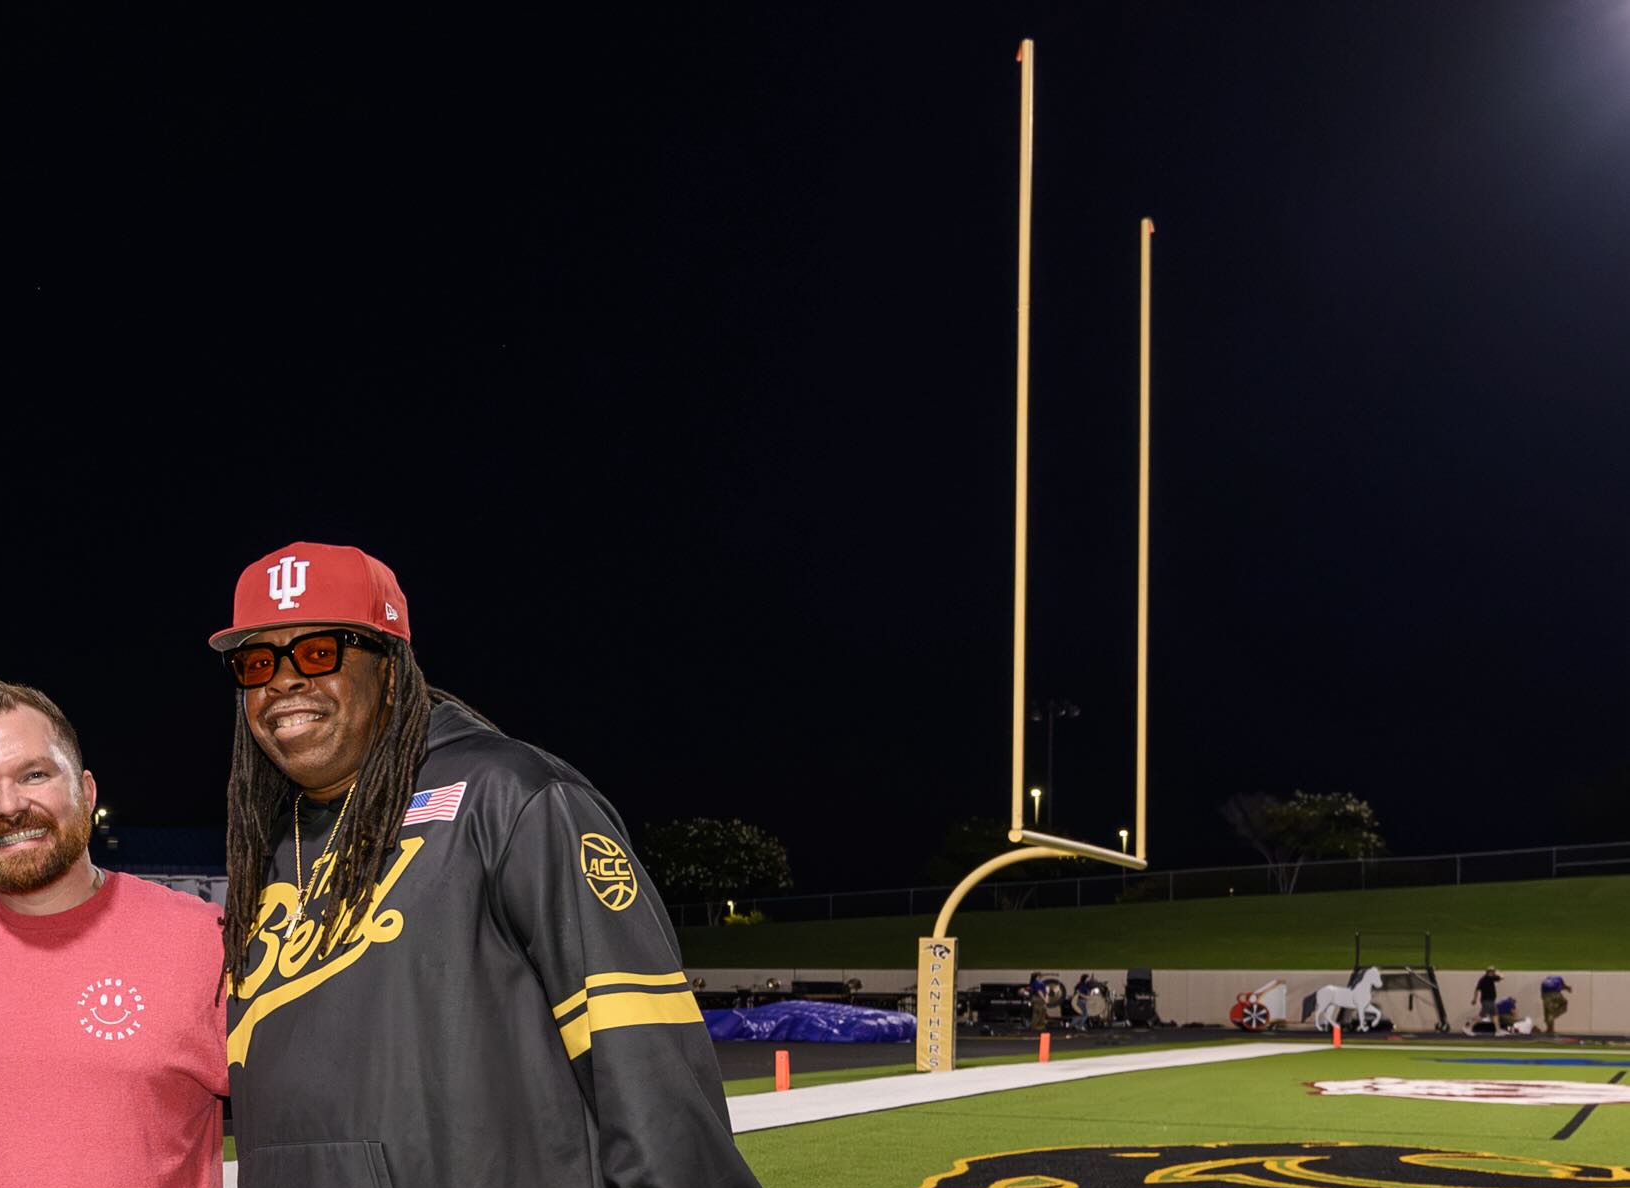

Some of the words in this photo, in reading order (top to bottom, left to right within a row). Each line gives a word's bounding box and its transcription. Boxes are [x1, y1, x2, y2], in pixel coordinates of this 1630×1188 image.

[589, 858, 630, 876] ACC
[77, 978, 123, 1007] LIVING
[128, 986, 145, 1011] FOR
[928, 963, 942, 1067] PANTHERS
